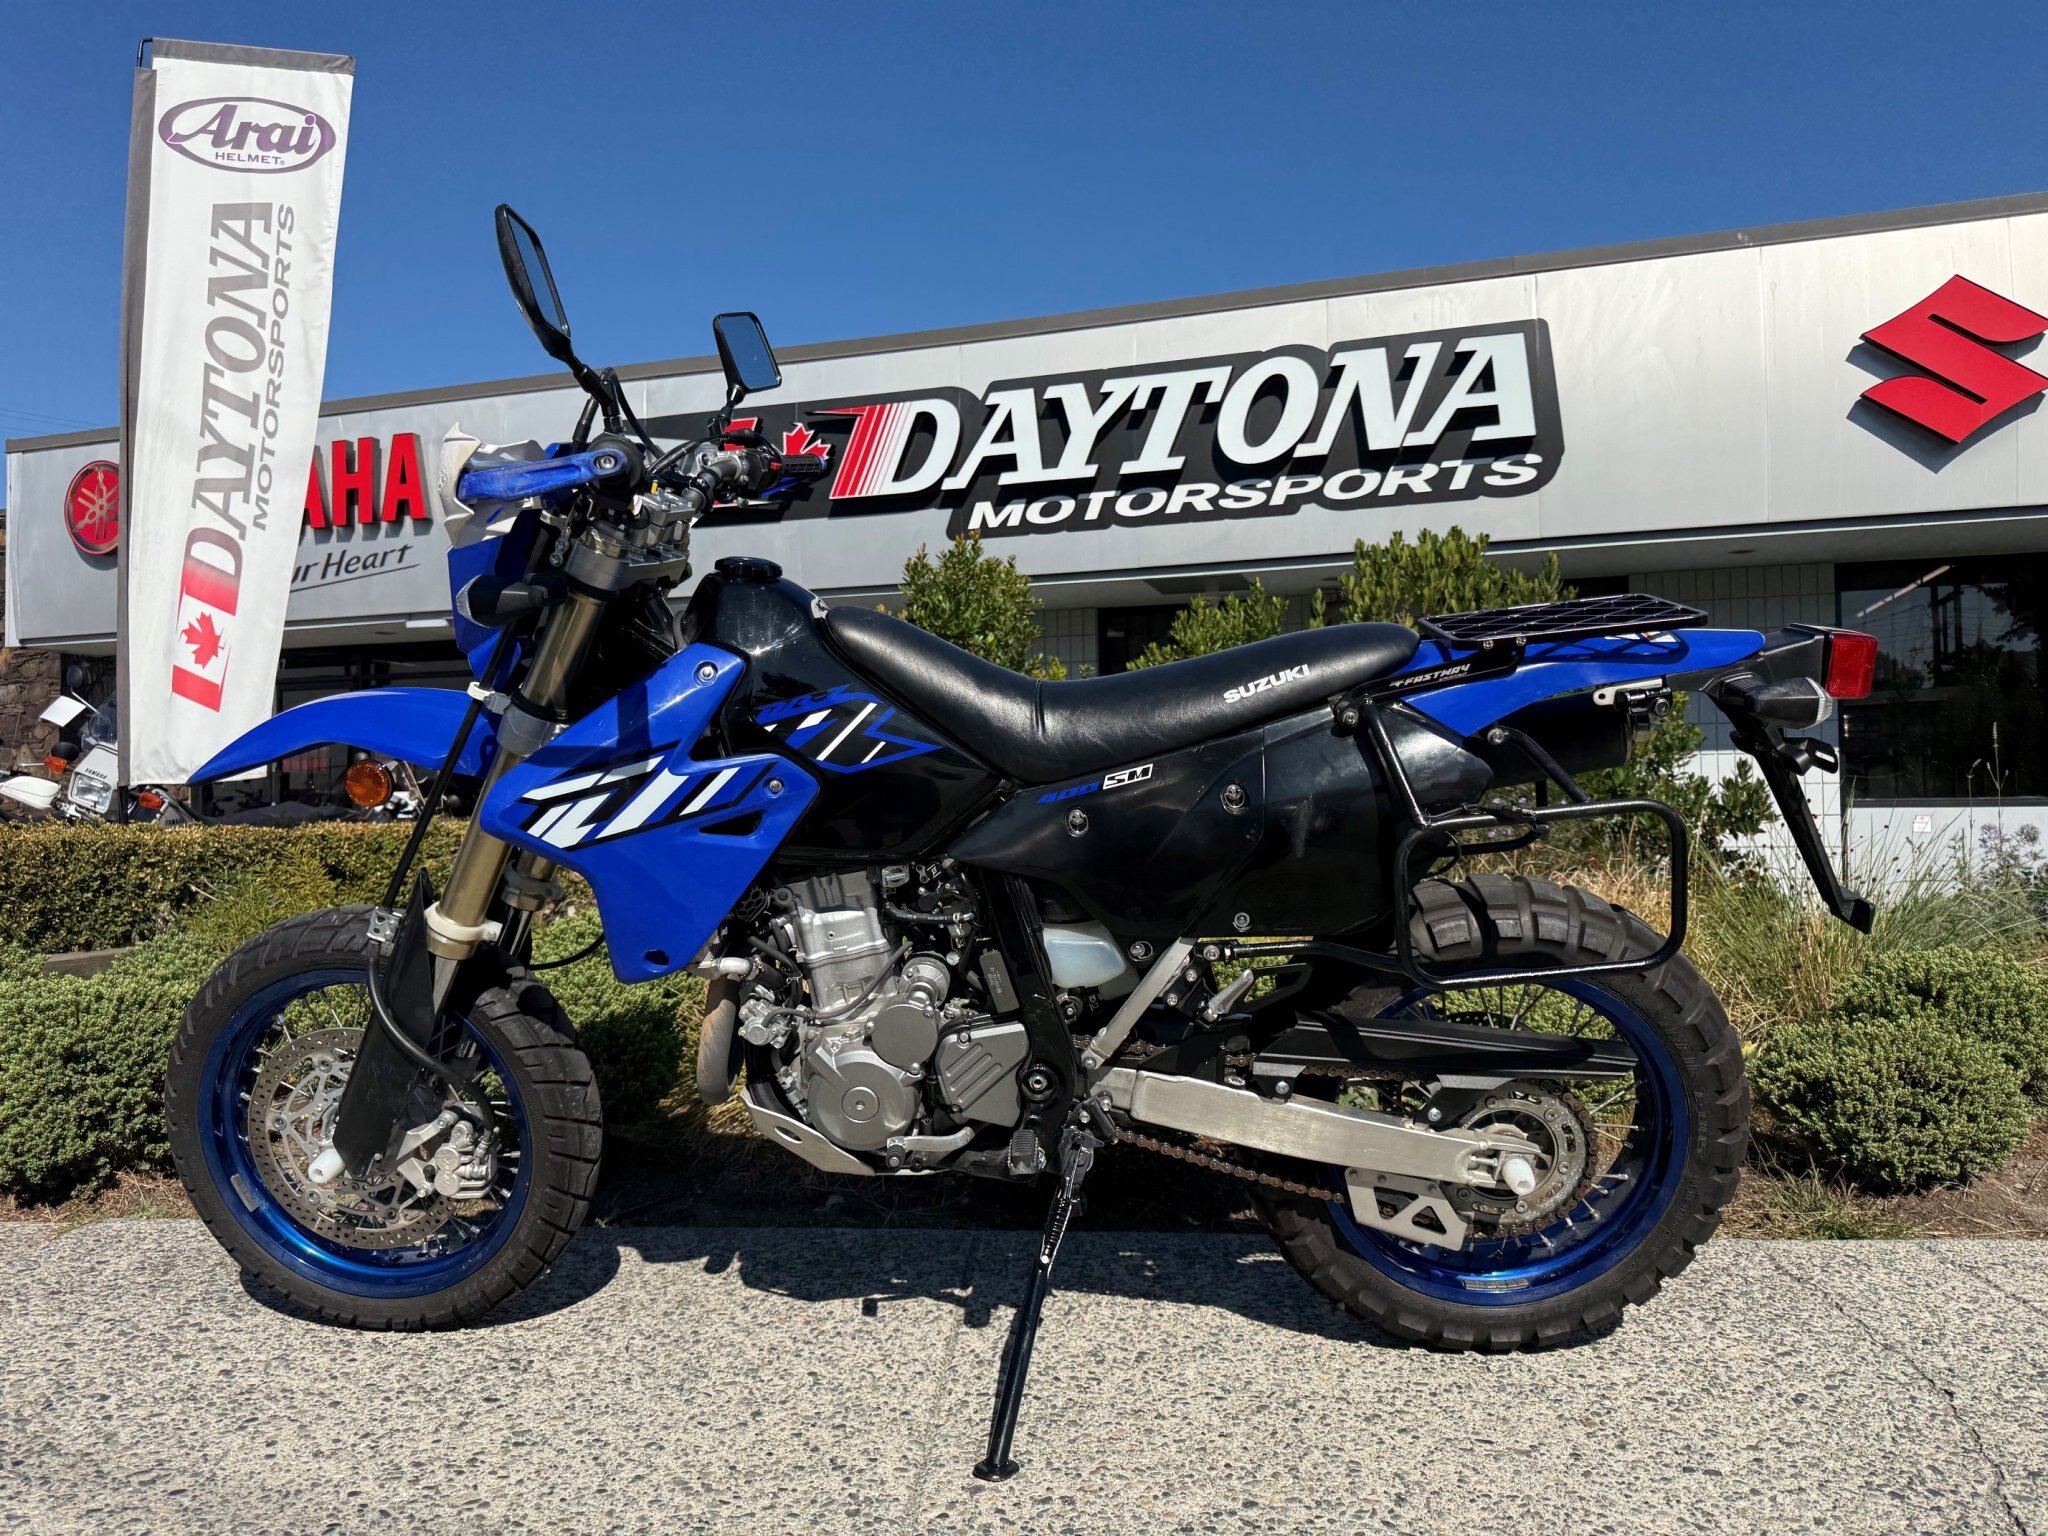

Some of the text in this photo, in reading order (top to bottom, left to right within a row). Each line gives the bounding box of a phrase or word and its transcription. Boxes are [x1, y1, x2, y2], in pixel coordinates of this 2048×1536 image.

[167, 104, 317, 154] Arai
[252, 204, 295, 532] MOTORSPORTS
[177, 202, 273, 616] DAYTONA
[816, 332, 1537, 499] DAYTONA
[967, 453, 1543, 530] MOTORSPORTS
[320, 544, 414, 580] Heart
[1223, 663, 1311, 703] SUZUKI
[1036, 765, 1152, 804] 400 SM
